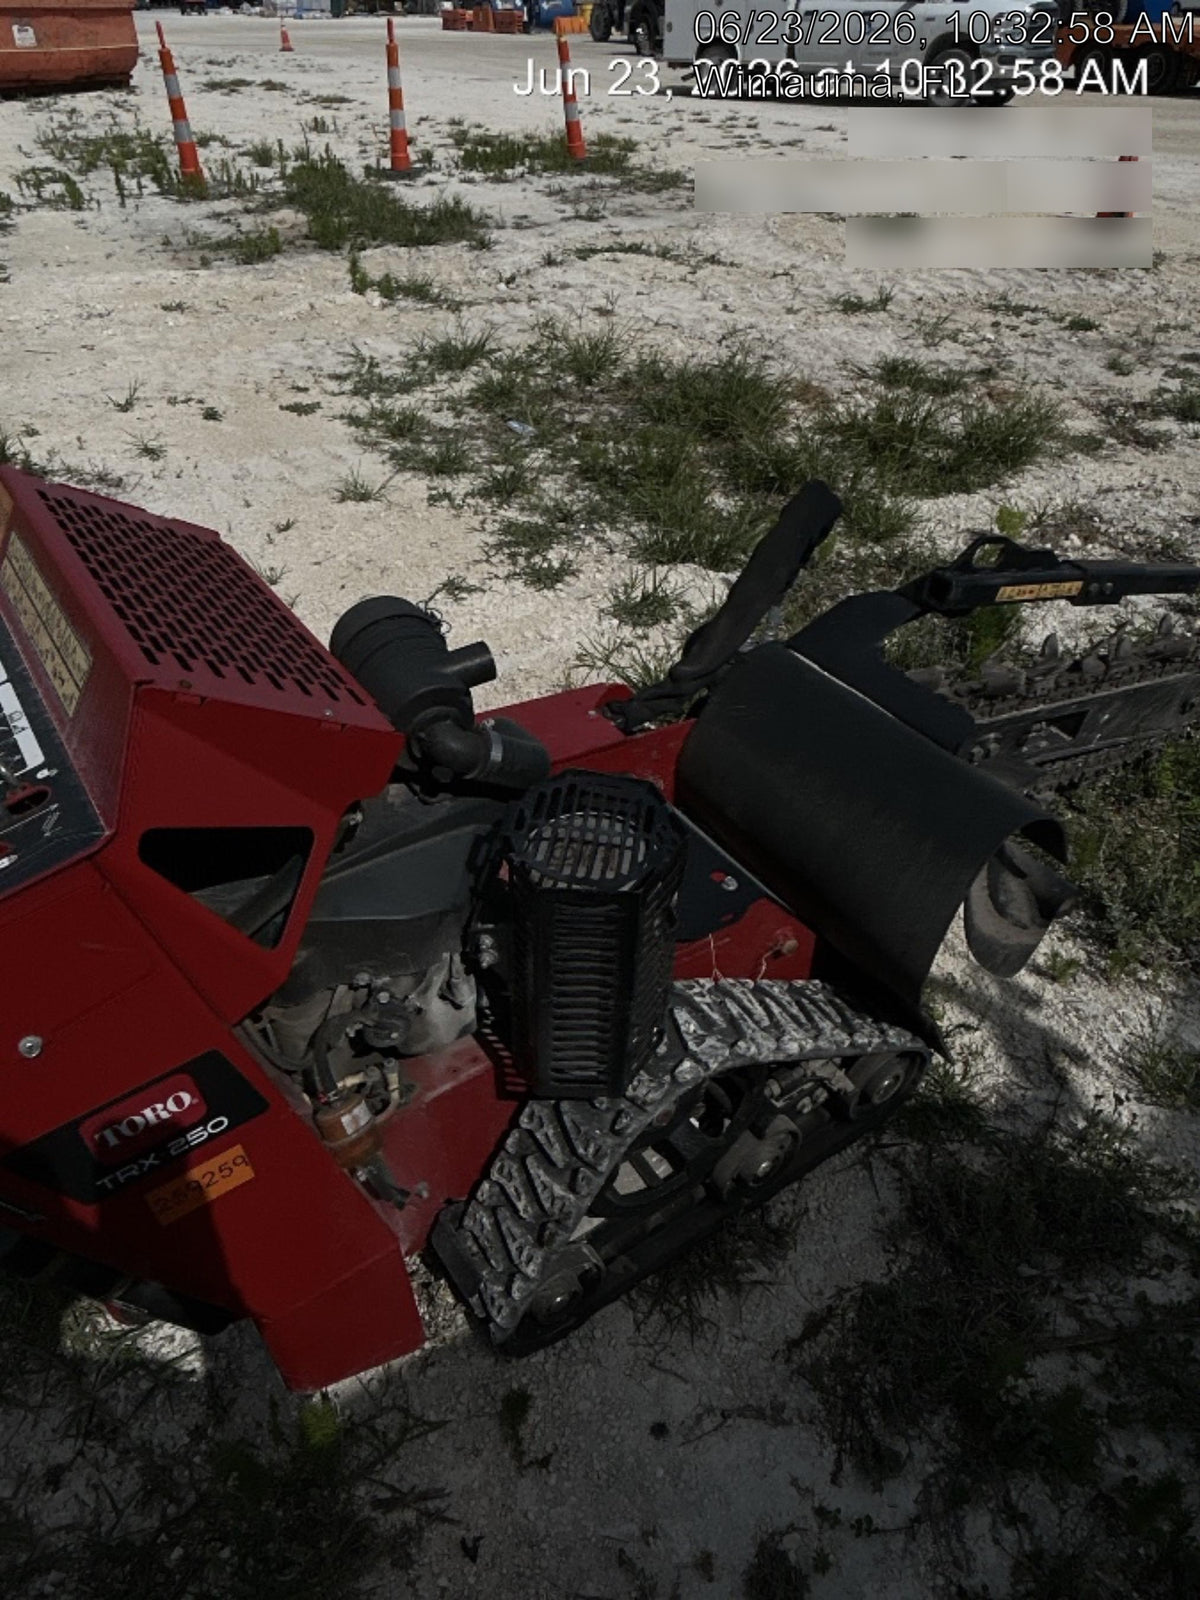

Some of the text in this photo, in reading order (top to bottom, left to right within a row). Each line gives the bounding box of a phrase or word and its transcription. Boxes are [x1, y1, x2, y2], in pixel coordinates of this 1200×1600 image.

[93, 1090, 196, 1148] TORO
[96, 1115, 229, 1190] TRX 250
